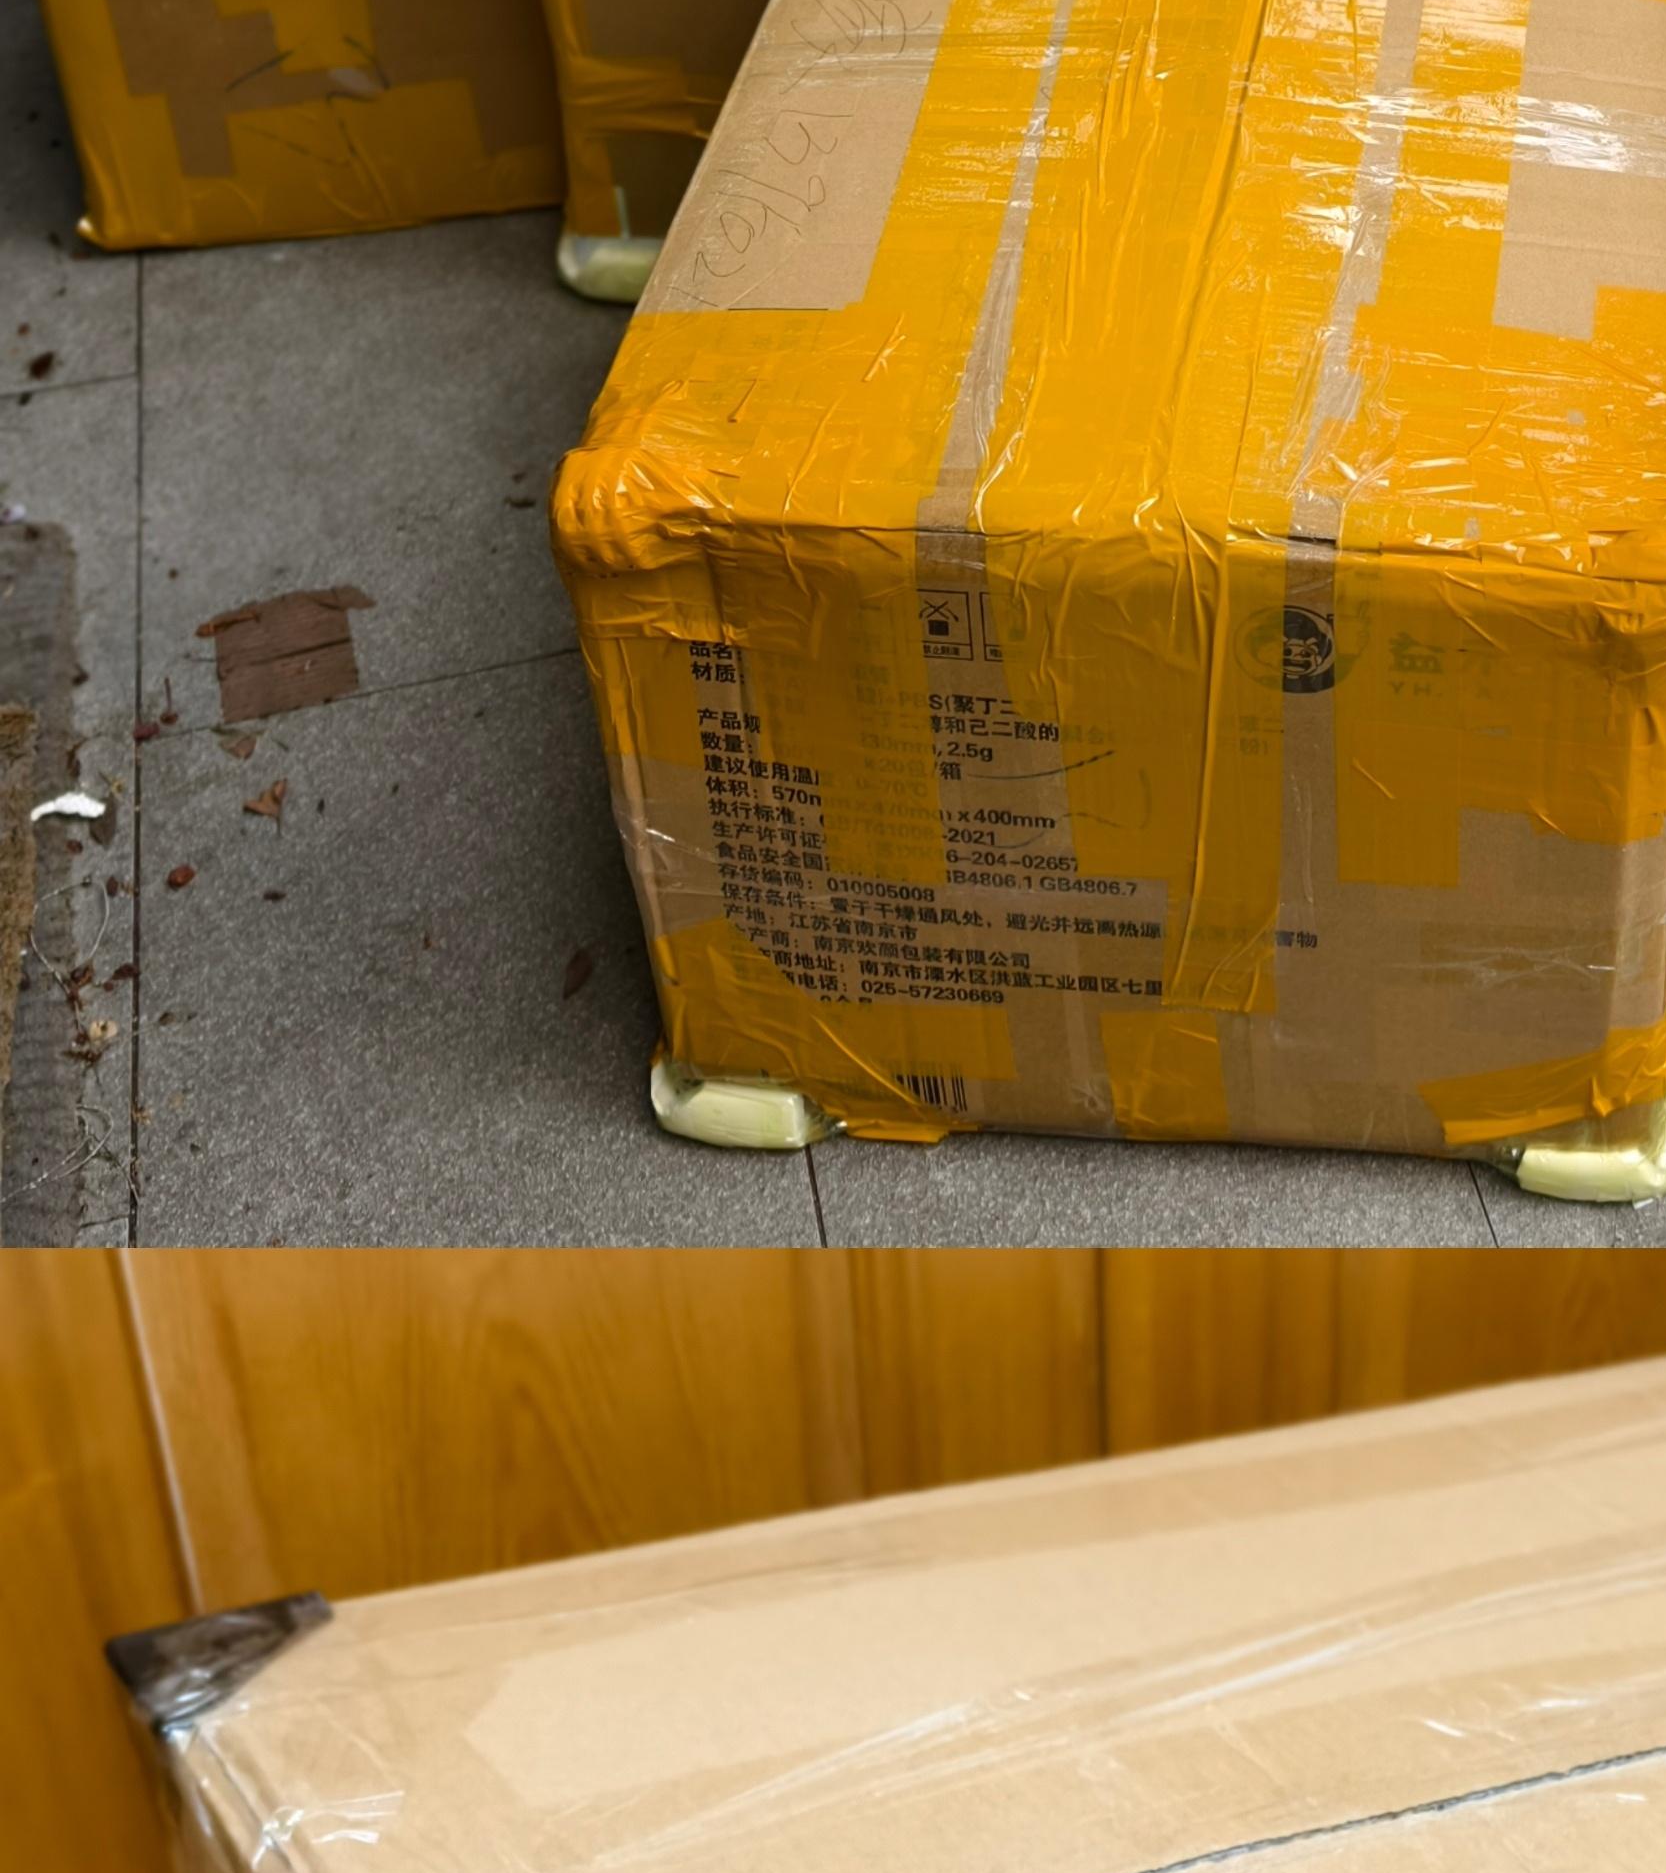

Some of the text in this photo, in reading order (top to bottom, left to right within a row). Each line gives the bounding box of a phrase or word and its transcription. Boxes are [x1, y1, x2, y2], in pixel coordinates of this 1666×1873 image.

[704, 754, 820, 786] 建议使用温
